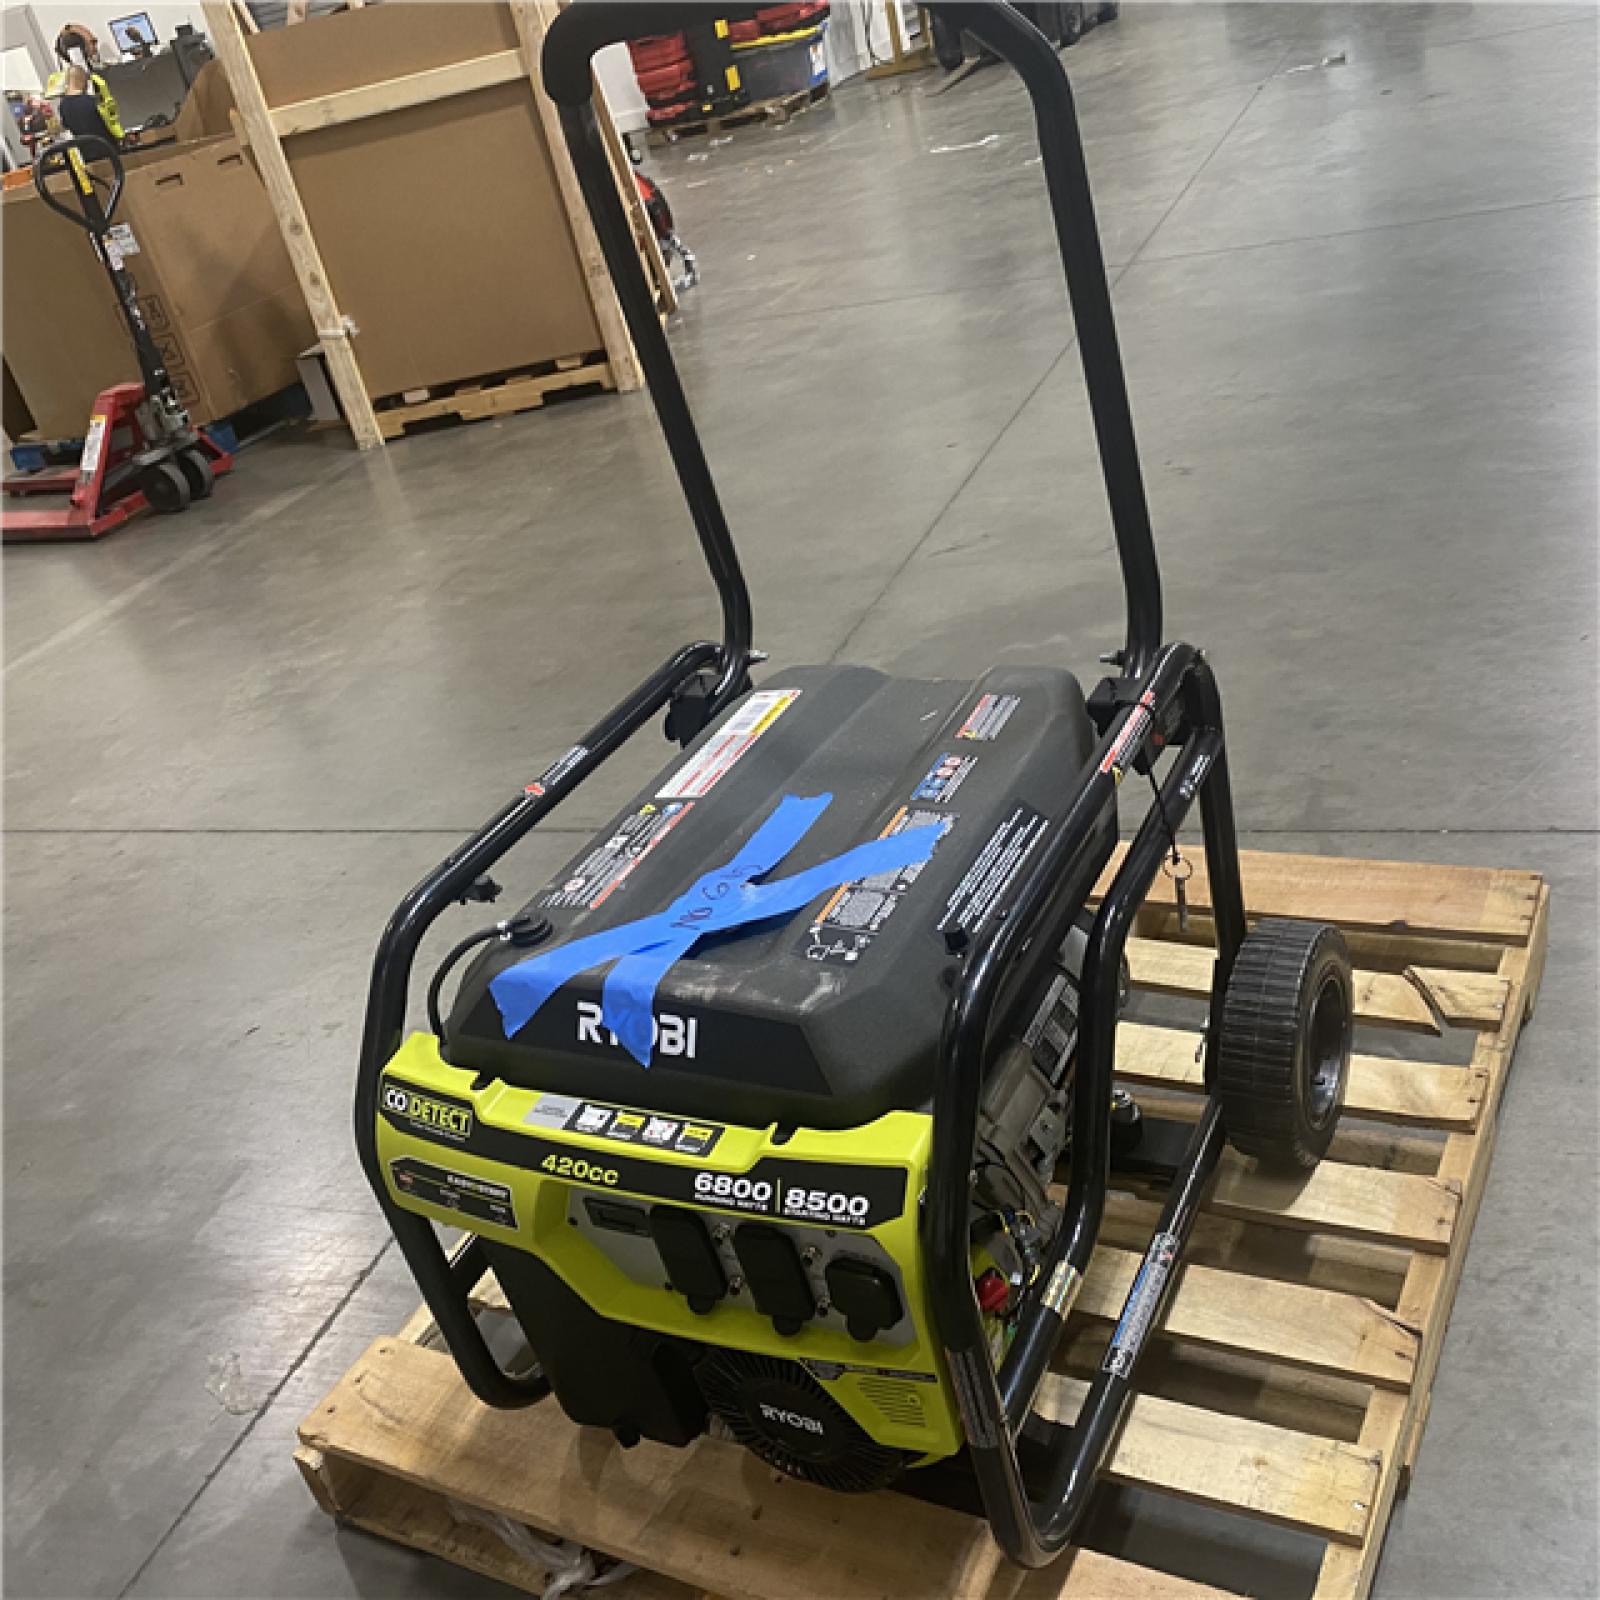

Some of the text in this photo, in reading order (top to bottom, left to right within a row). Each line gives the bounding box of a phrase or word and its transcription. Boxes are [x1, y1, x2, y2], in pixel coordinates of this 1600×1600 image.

[576, 1000, 697, 1059] RBI
[386, 1089, 469, 1132] CO DETECT
[541, 1154, 620, 1186] 420cc
[694, 1172, 772, 1201] 6800
[784, 1187, 869, 1216] 8500
